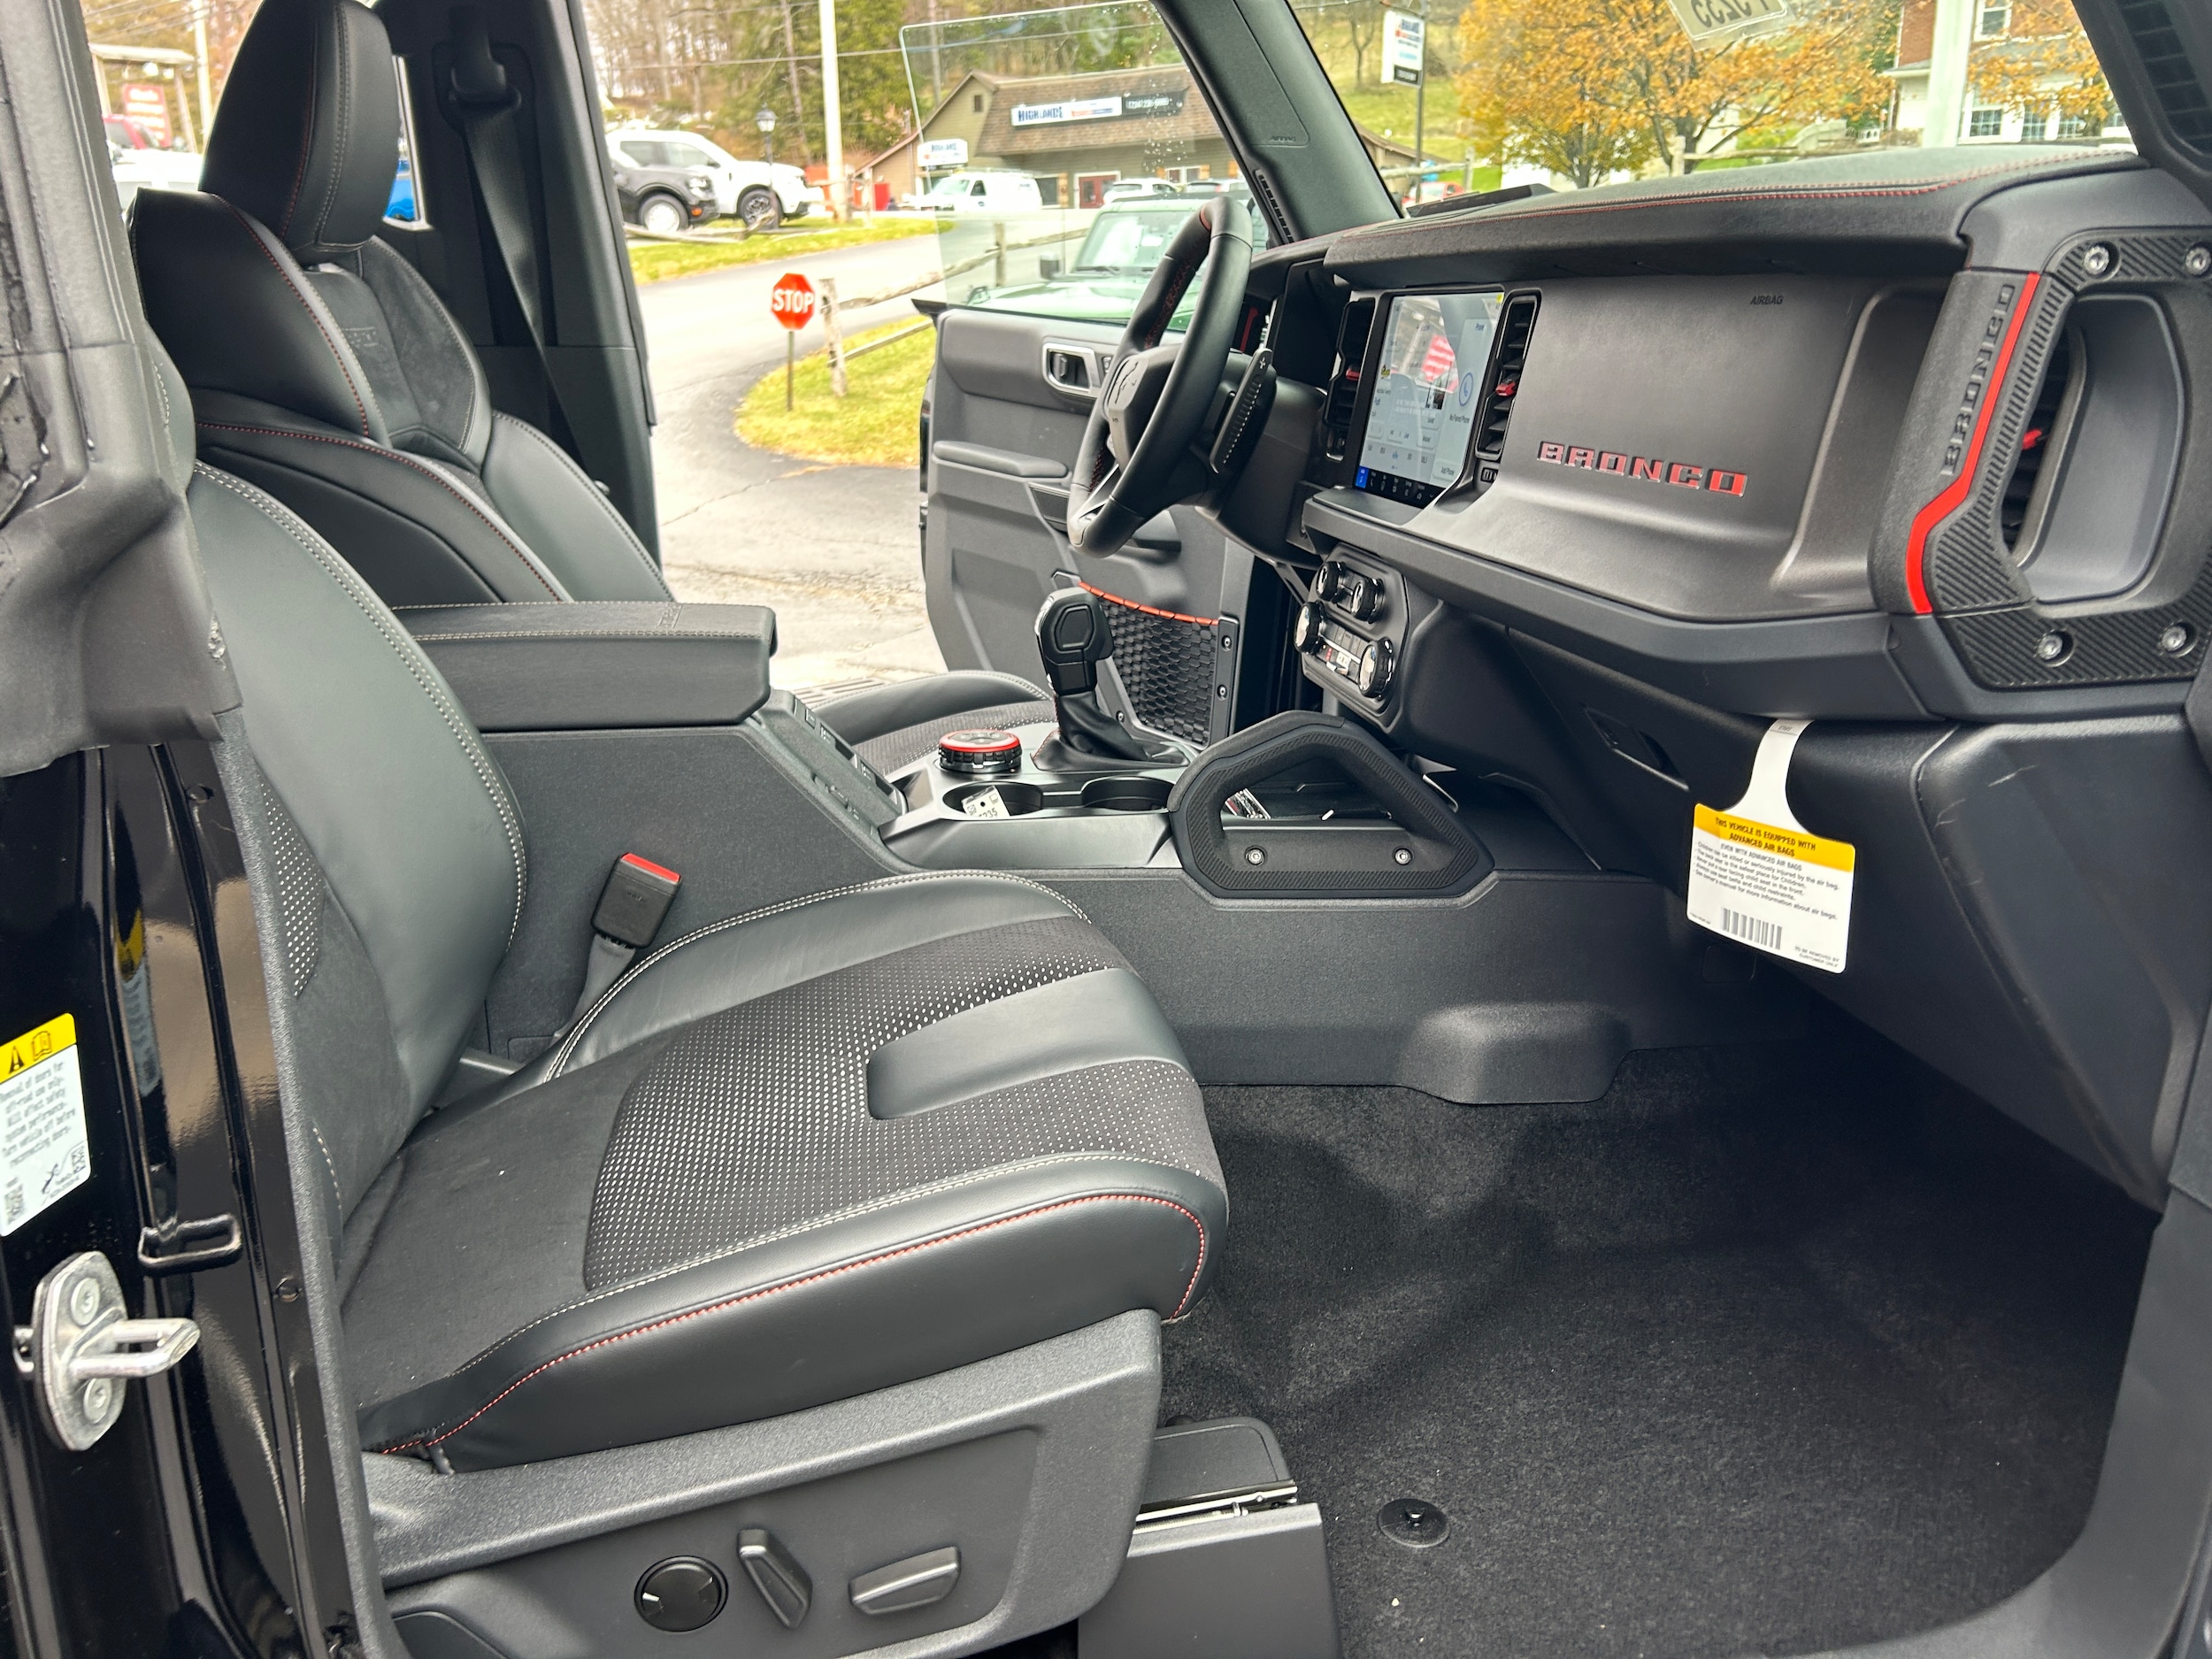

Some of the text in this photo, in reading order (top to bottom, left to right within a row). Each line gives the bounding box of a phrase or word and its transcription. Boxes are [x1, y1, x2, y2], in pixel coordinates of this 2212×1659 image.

[772, 288, 815, 314] STOP
[1750, 295, 1784, 305] AIRBAG
[1939, 283, 2016, 476] BRONCO
[1537, 441, 1747, 497] BRONCO
[1716, 817, 1727, 827] THIS
[1729, 821, 1754, 834] VEHICLE
[1763, 831, 1796, 846] EQUIPPED
[1798, 840, 1816, 851] WITH
[1729, 833, 1794, 857] ADVANCED AIR BAGS
[1721, 843, 1733, 852] EVEN
[1735, 848, 1747, 856] WITH
[1748, 851, 1775, 864] ADVANCED
[1787, 862, 1802, 872] BAGS
[1729, 869, 1744, 879] facing
[1751, 862, 1775, 873] seriously
[1777, 868, 1796, 878] injured
[1826, 881, 1839, 891] bag.
[1780, 877, 1806, 888] Children.
[1761, 893, 1793, 907] information
[1793, 903, 1810, 912] about
